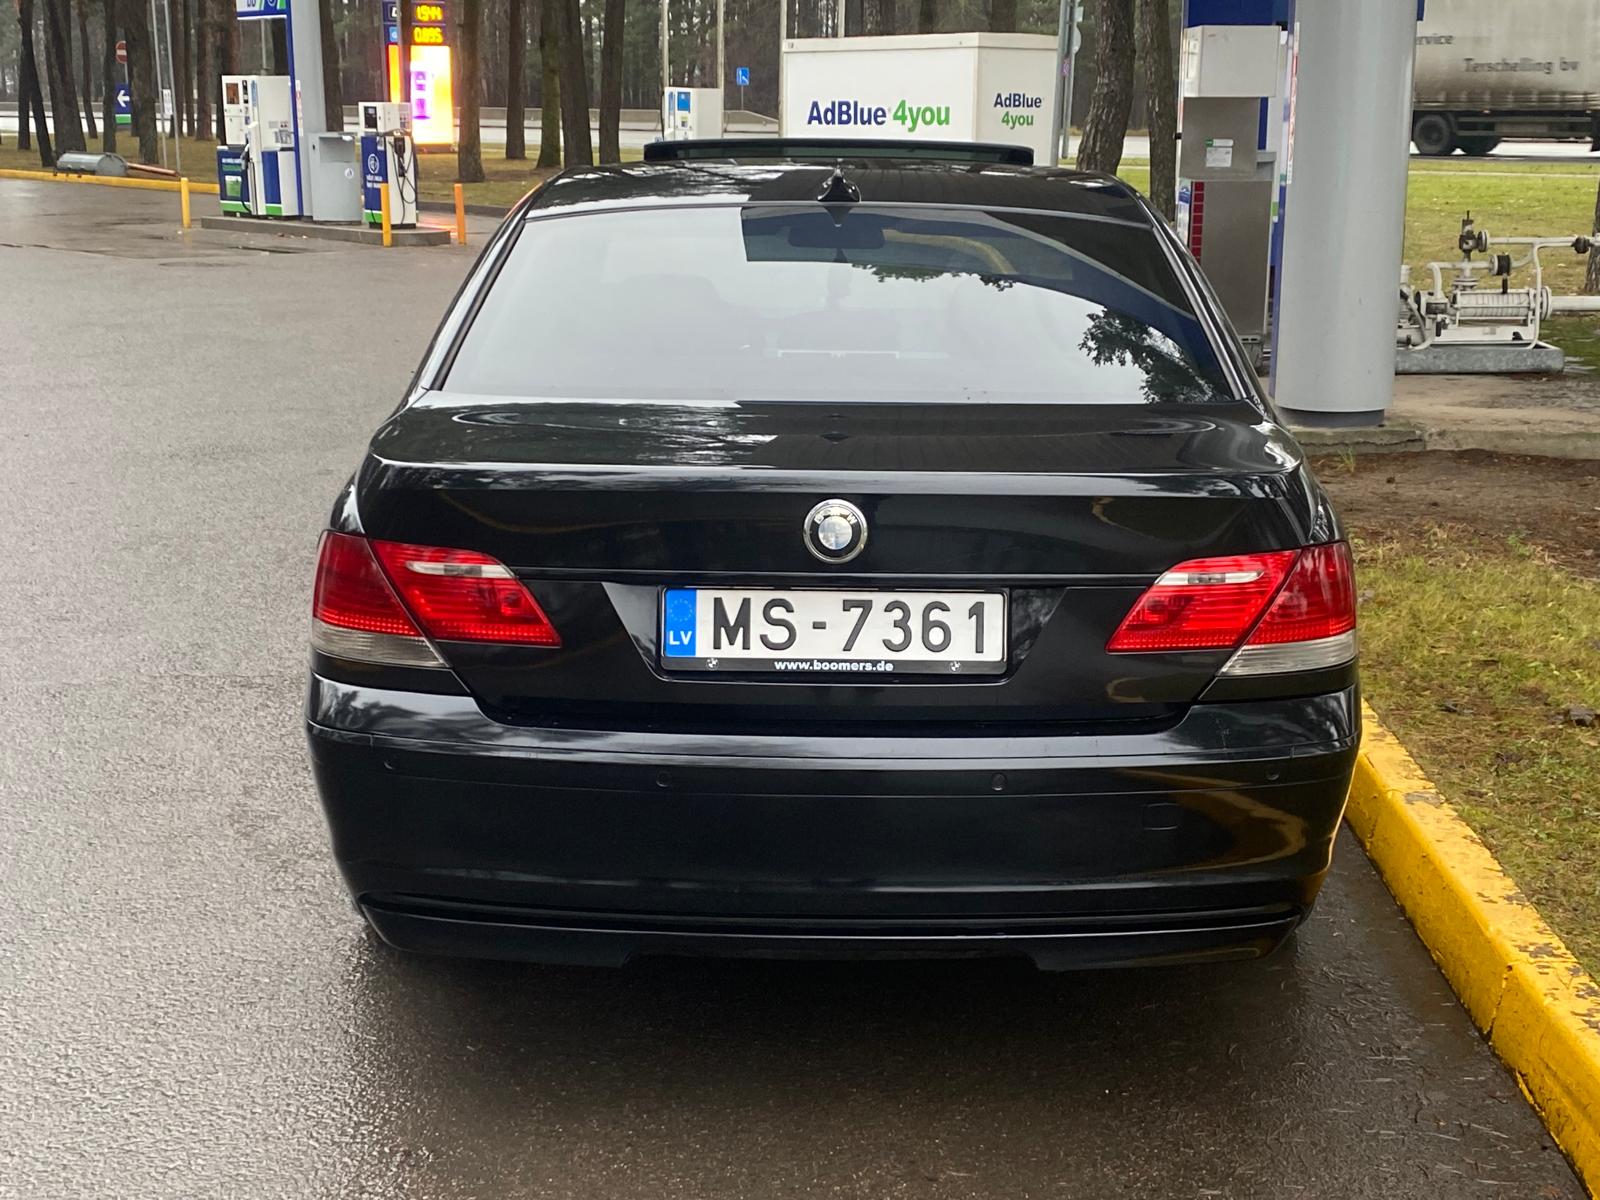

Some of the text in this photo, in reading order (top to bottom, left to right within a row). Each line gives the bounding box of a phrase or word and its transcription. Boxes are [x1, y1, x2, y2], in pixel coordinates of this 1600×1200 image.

[993, 93, 1042, 108] AdBlue
[807, 100, 950, 133] AdBlue 4you
[1001, 111, 1034, 130] 4you
[713, 597, 985, 653] MS-7361
[669, 630, 692, 645] LV
[774, 660, 894, 672] www.boomers.de
